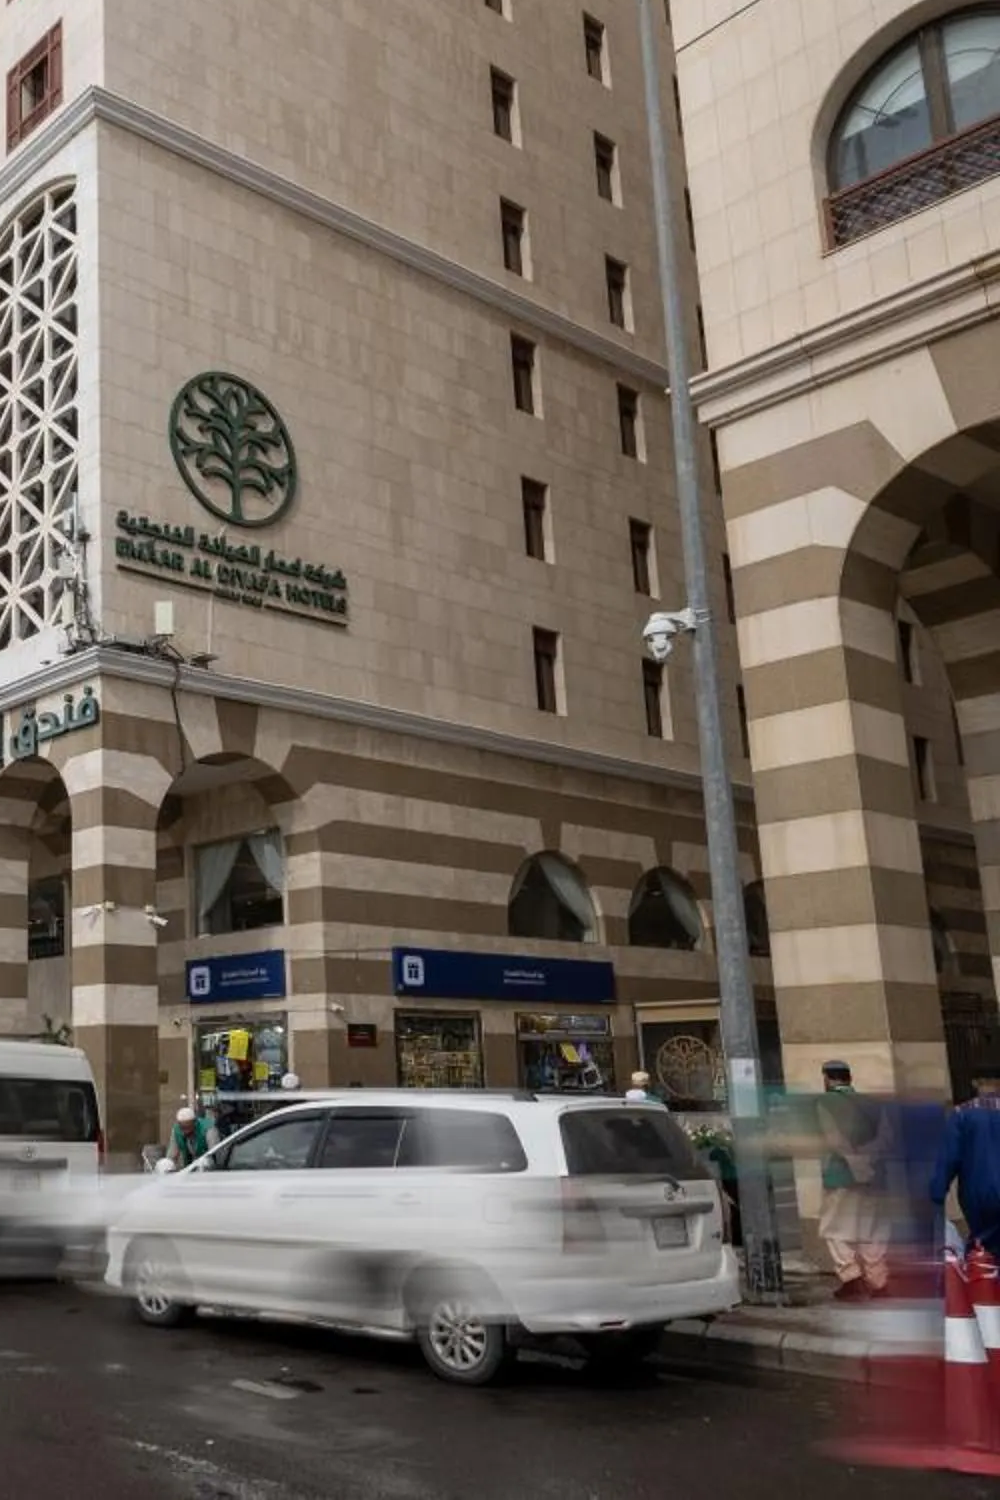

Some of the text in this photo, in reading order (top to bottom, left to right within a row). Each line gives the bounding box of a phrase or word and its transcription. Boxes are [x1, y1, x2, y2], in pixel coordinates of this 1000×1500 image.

[116, 509, 195, 548] الفندقية
[115, 536, 184, 573] EMAAR
[190, 556, 213, 580] AL
[286, 582, 347, 615] HOTELS
[9, 685, 100, 762] فندق
